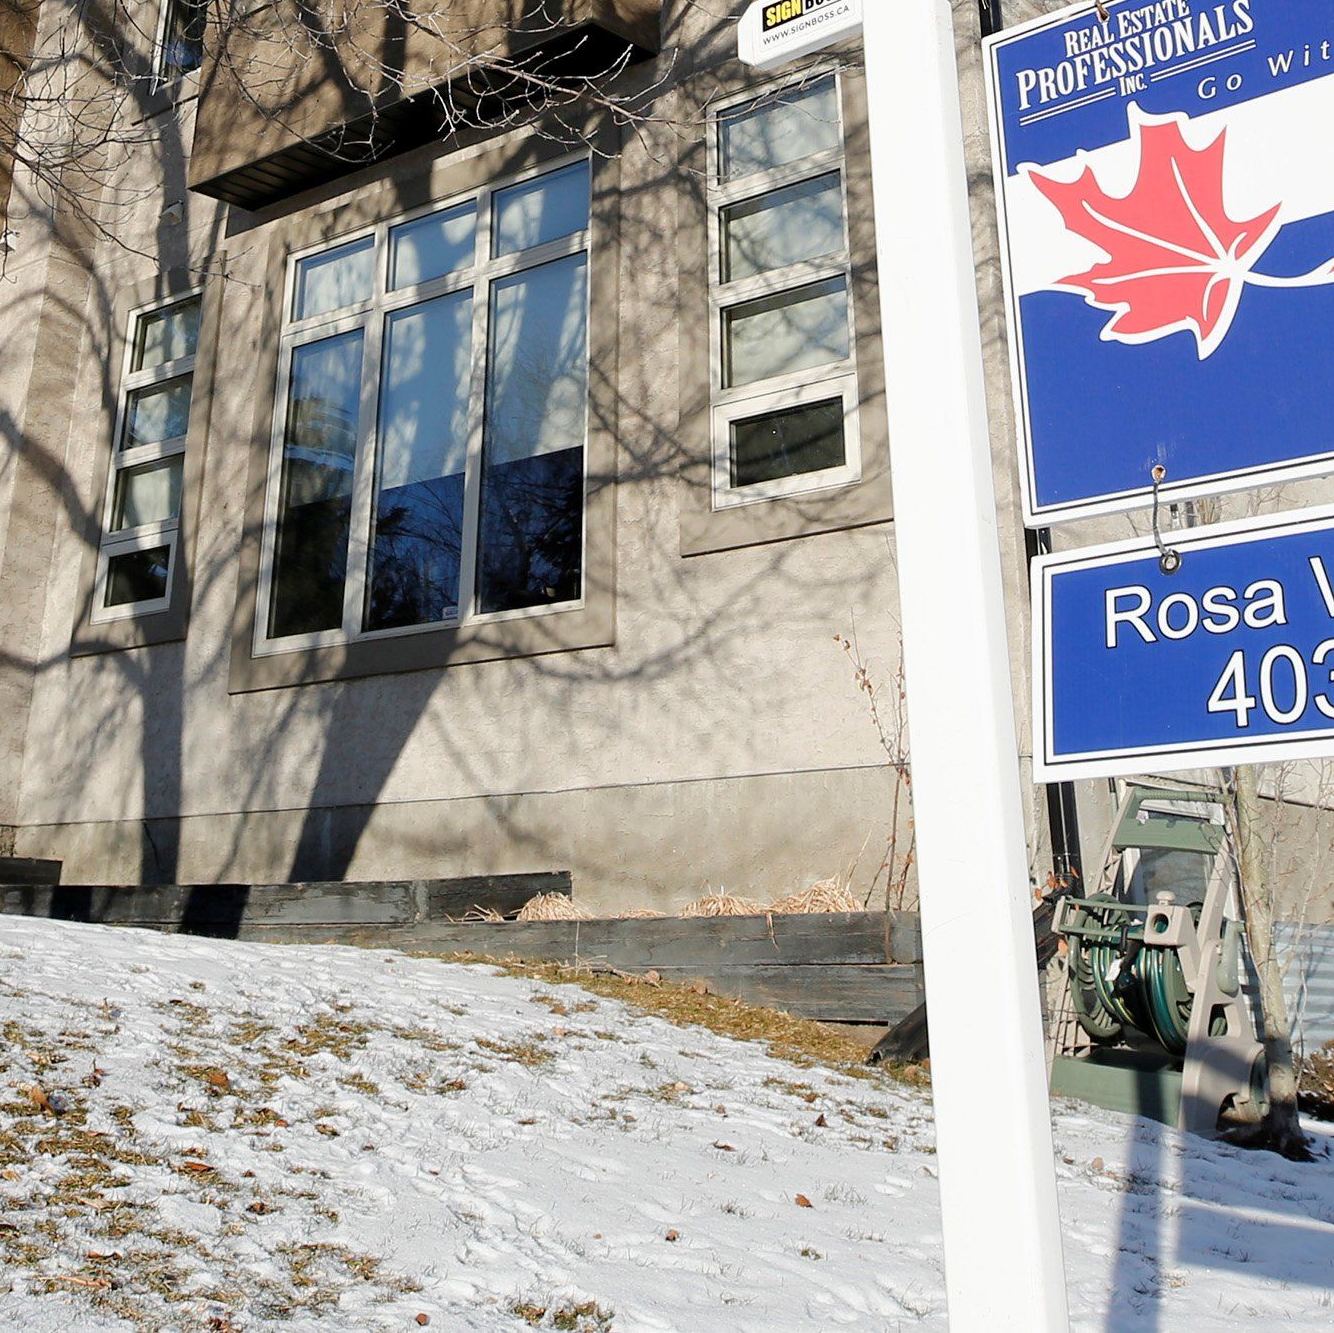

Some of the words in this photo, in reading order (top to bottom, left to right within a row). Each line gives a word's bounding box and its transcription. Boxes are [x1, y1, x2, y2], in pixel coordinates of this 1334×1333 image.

[762, 4, 850, 46] WWW.SIGNBOSS.CA
[1063, 20, 1116, 58] REAL
[1118, 73, 1148, 97] INC.
[1196, 73, 1243, 100] Go
[1104, 578, 1286, 649] Rosa
